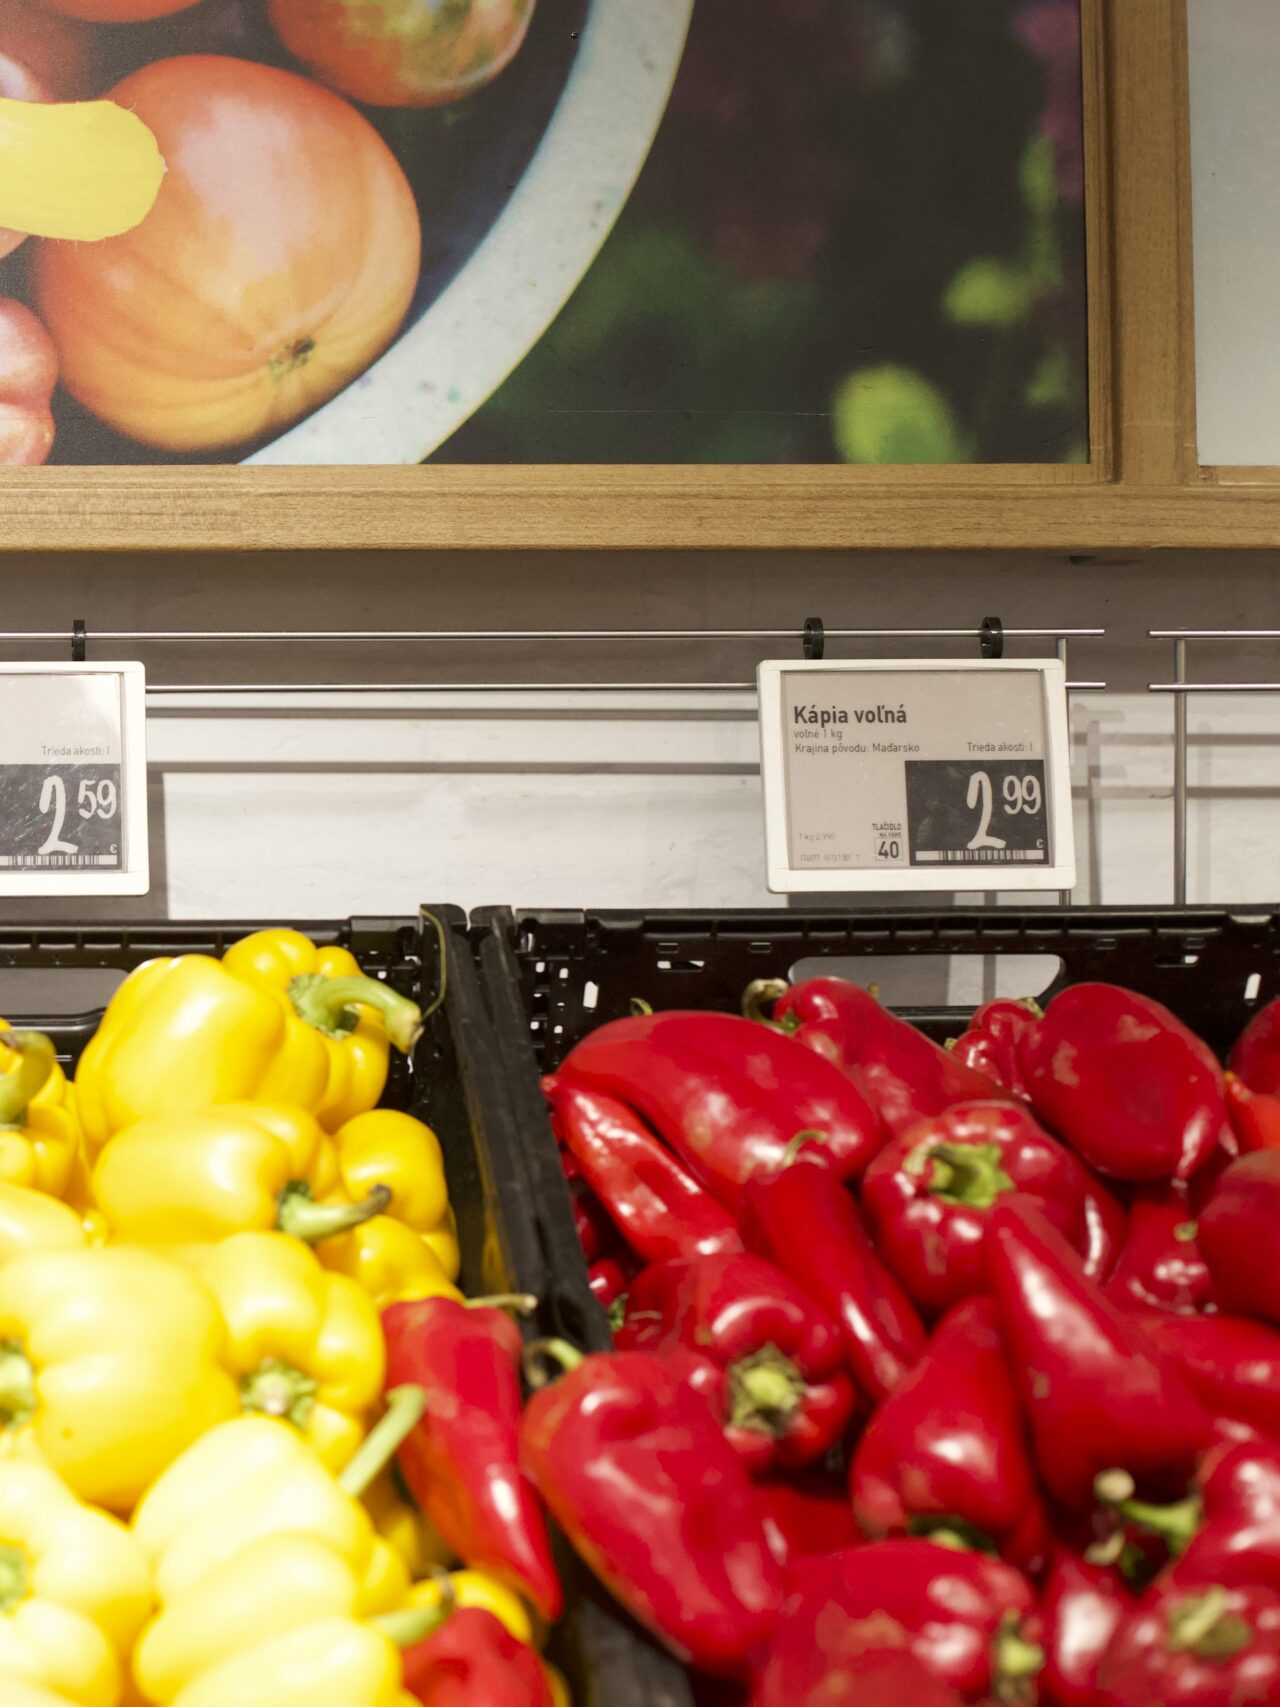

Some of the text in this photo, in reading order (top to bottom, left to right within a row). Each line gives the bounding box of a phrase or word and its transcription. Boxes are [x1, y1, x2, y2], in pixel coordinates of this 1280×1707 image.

[793, 703, 908, 728] Kápia voľná
[823, 729, 827, 738] 1
[831, 729, 843, 741] kg
[41, 745, 71, 756] Trieda
[795, 744, 829, 755] Krajina
[872, 743, 920, 753] Maďarsko
[966, 742, 996, 752] Trieda
[37, 774, 117, 855] 2 59
[966, 770, 1042, 850] 2 99
[878, 840, 899, 860] 40
